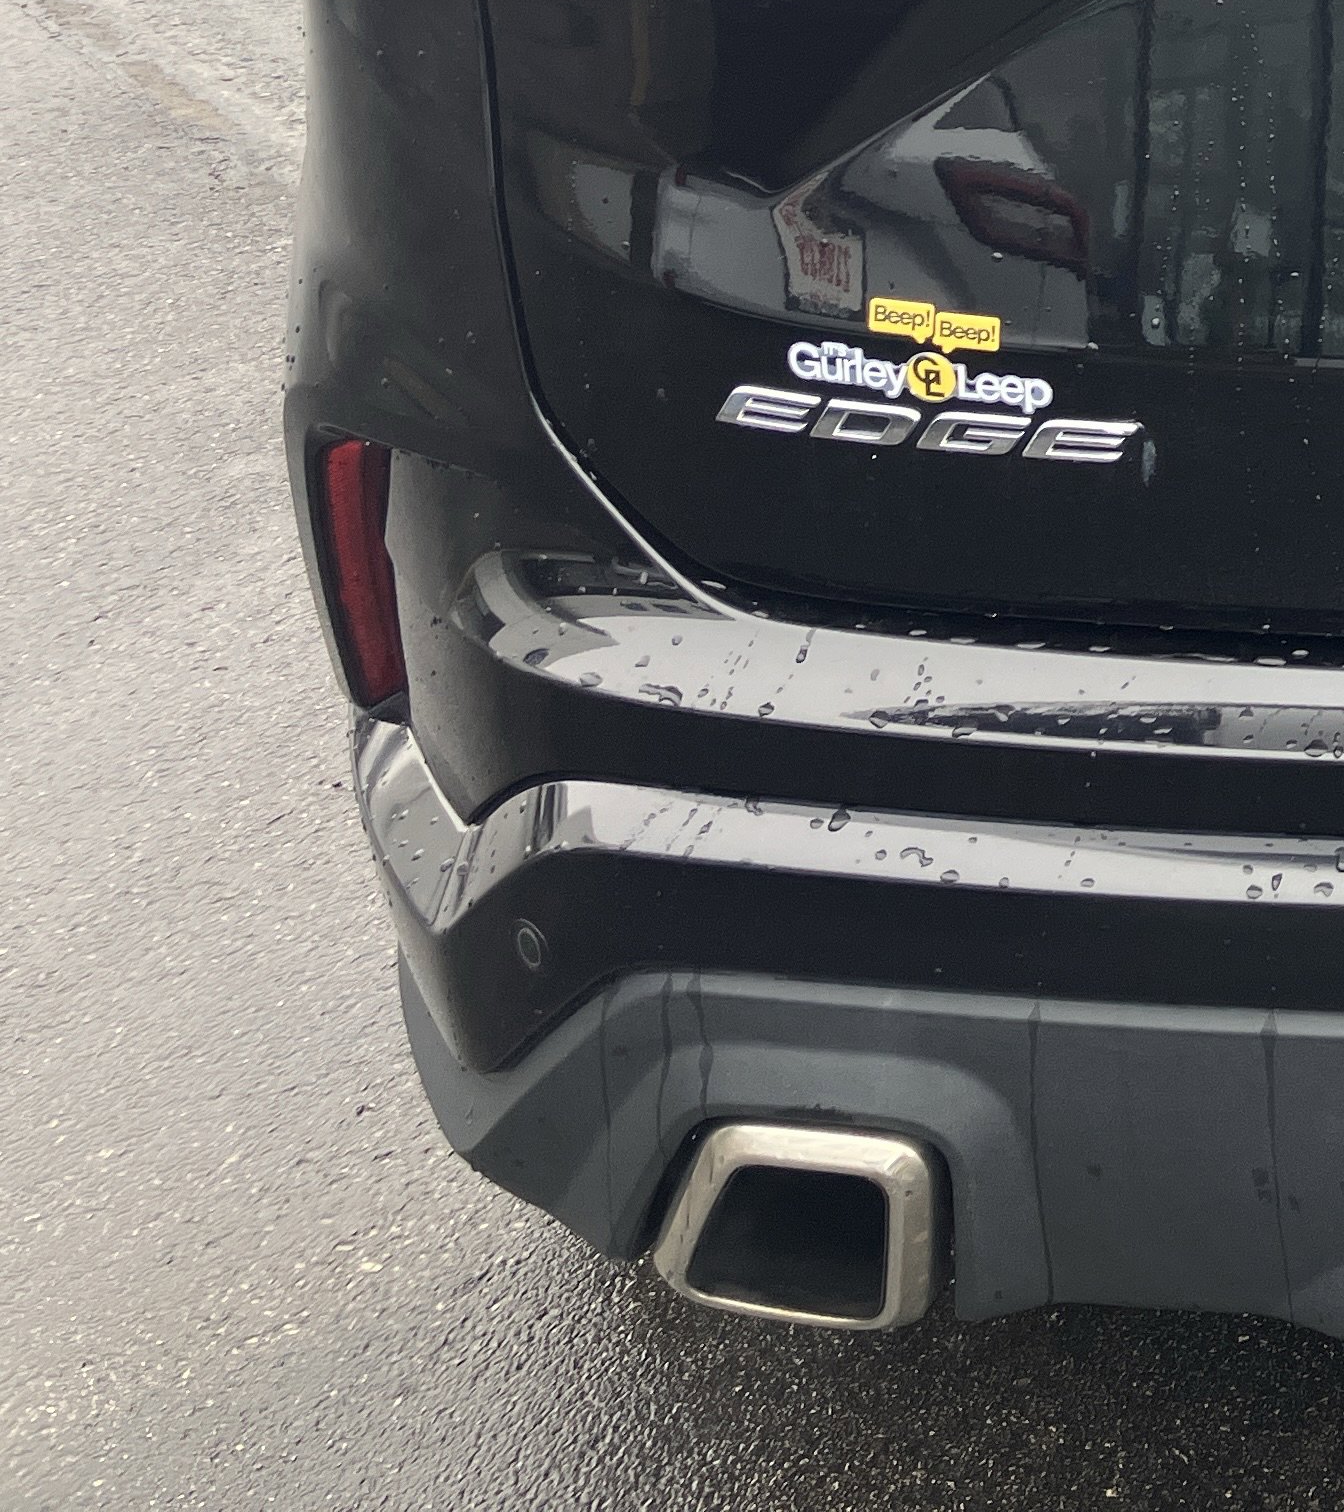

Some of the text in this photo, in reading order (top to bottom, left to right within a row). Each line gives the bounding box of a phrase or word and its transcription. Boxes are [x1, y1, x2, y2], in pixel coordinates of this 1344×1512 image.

[873, 304, 997, 343] Beep! Beep!
[791, 344, 907, 398] Gurley
[957, 365, 1050, 413] Leep
[715, 385, 1145, 463] EDGE
